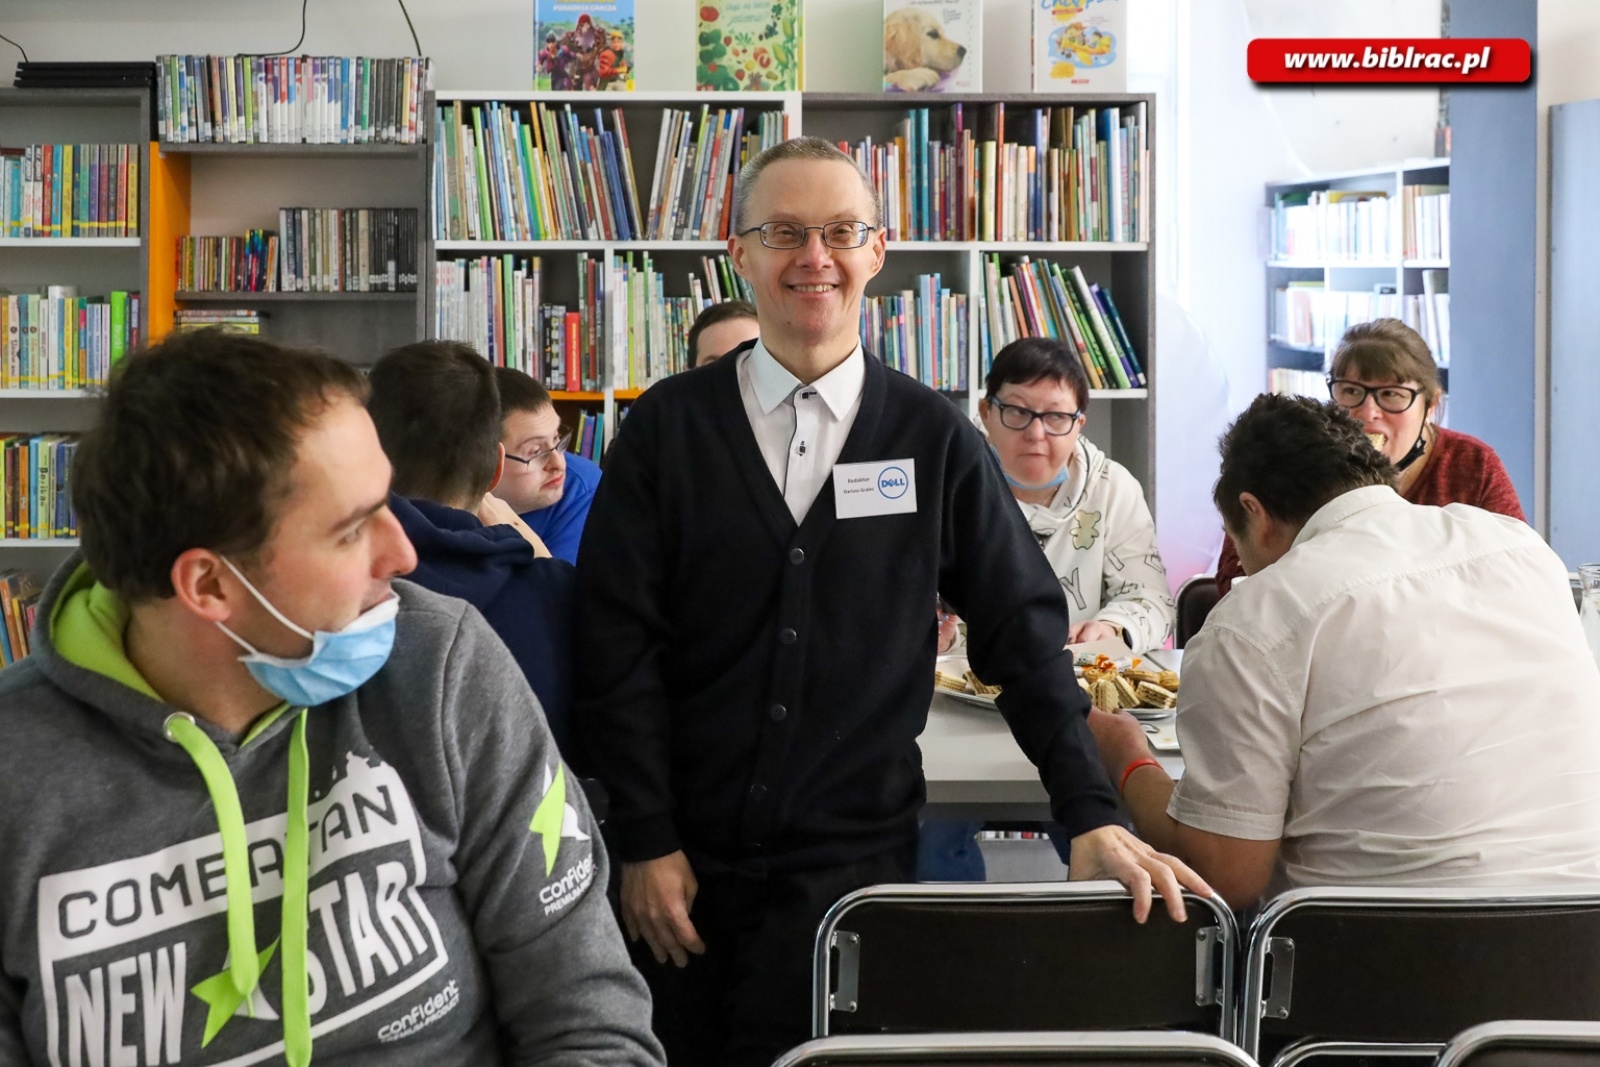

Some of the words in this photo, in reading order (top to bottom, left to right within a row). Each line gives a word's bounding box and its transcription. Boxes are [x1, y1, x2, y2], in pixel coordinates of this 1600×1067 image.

[881, 478, 905, 488] DELL
[539, 853, 595, 905] confide
[65, 941, 187, 1067] NEW
[377, 979, 460, 1040] confident
